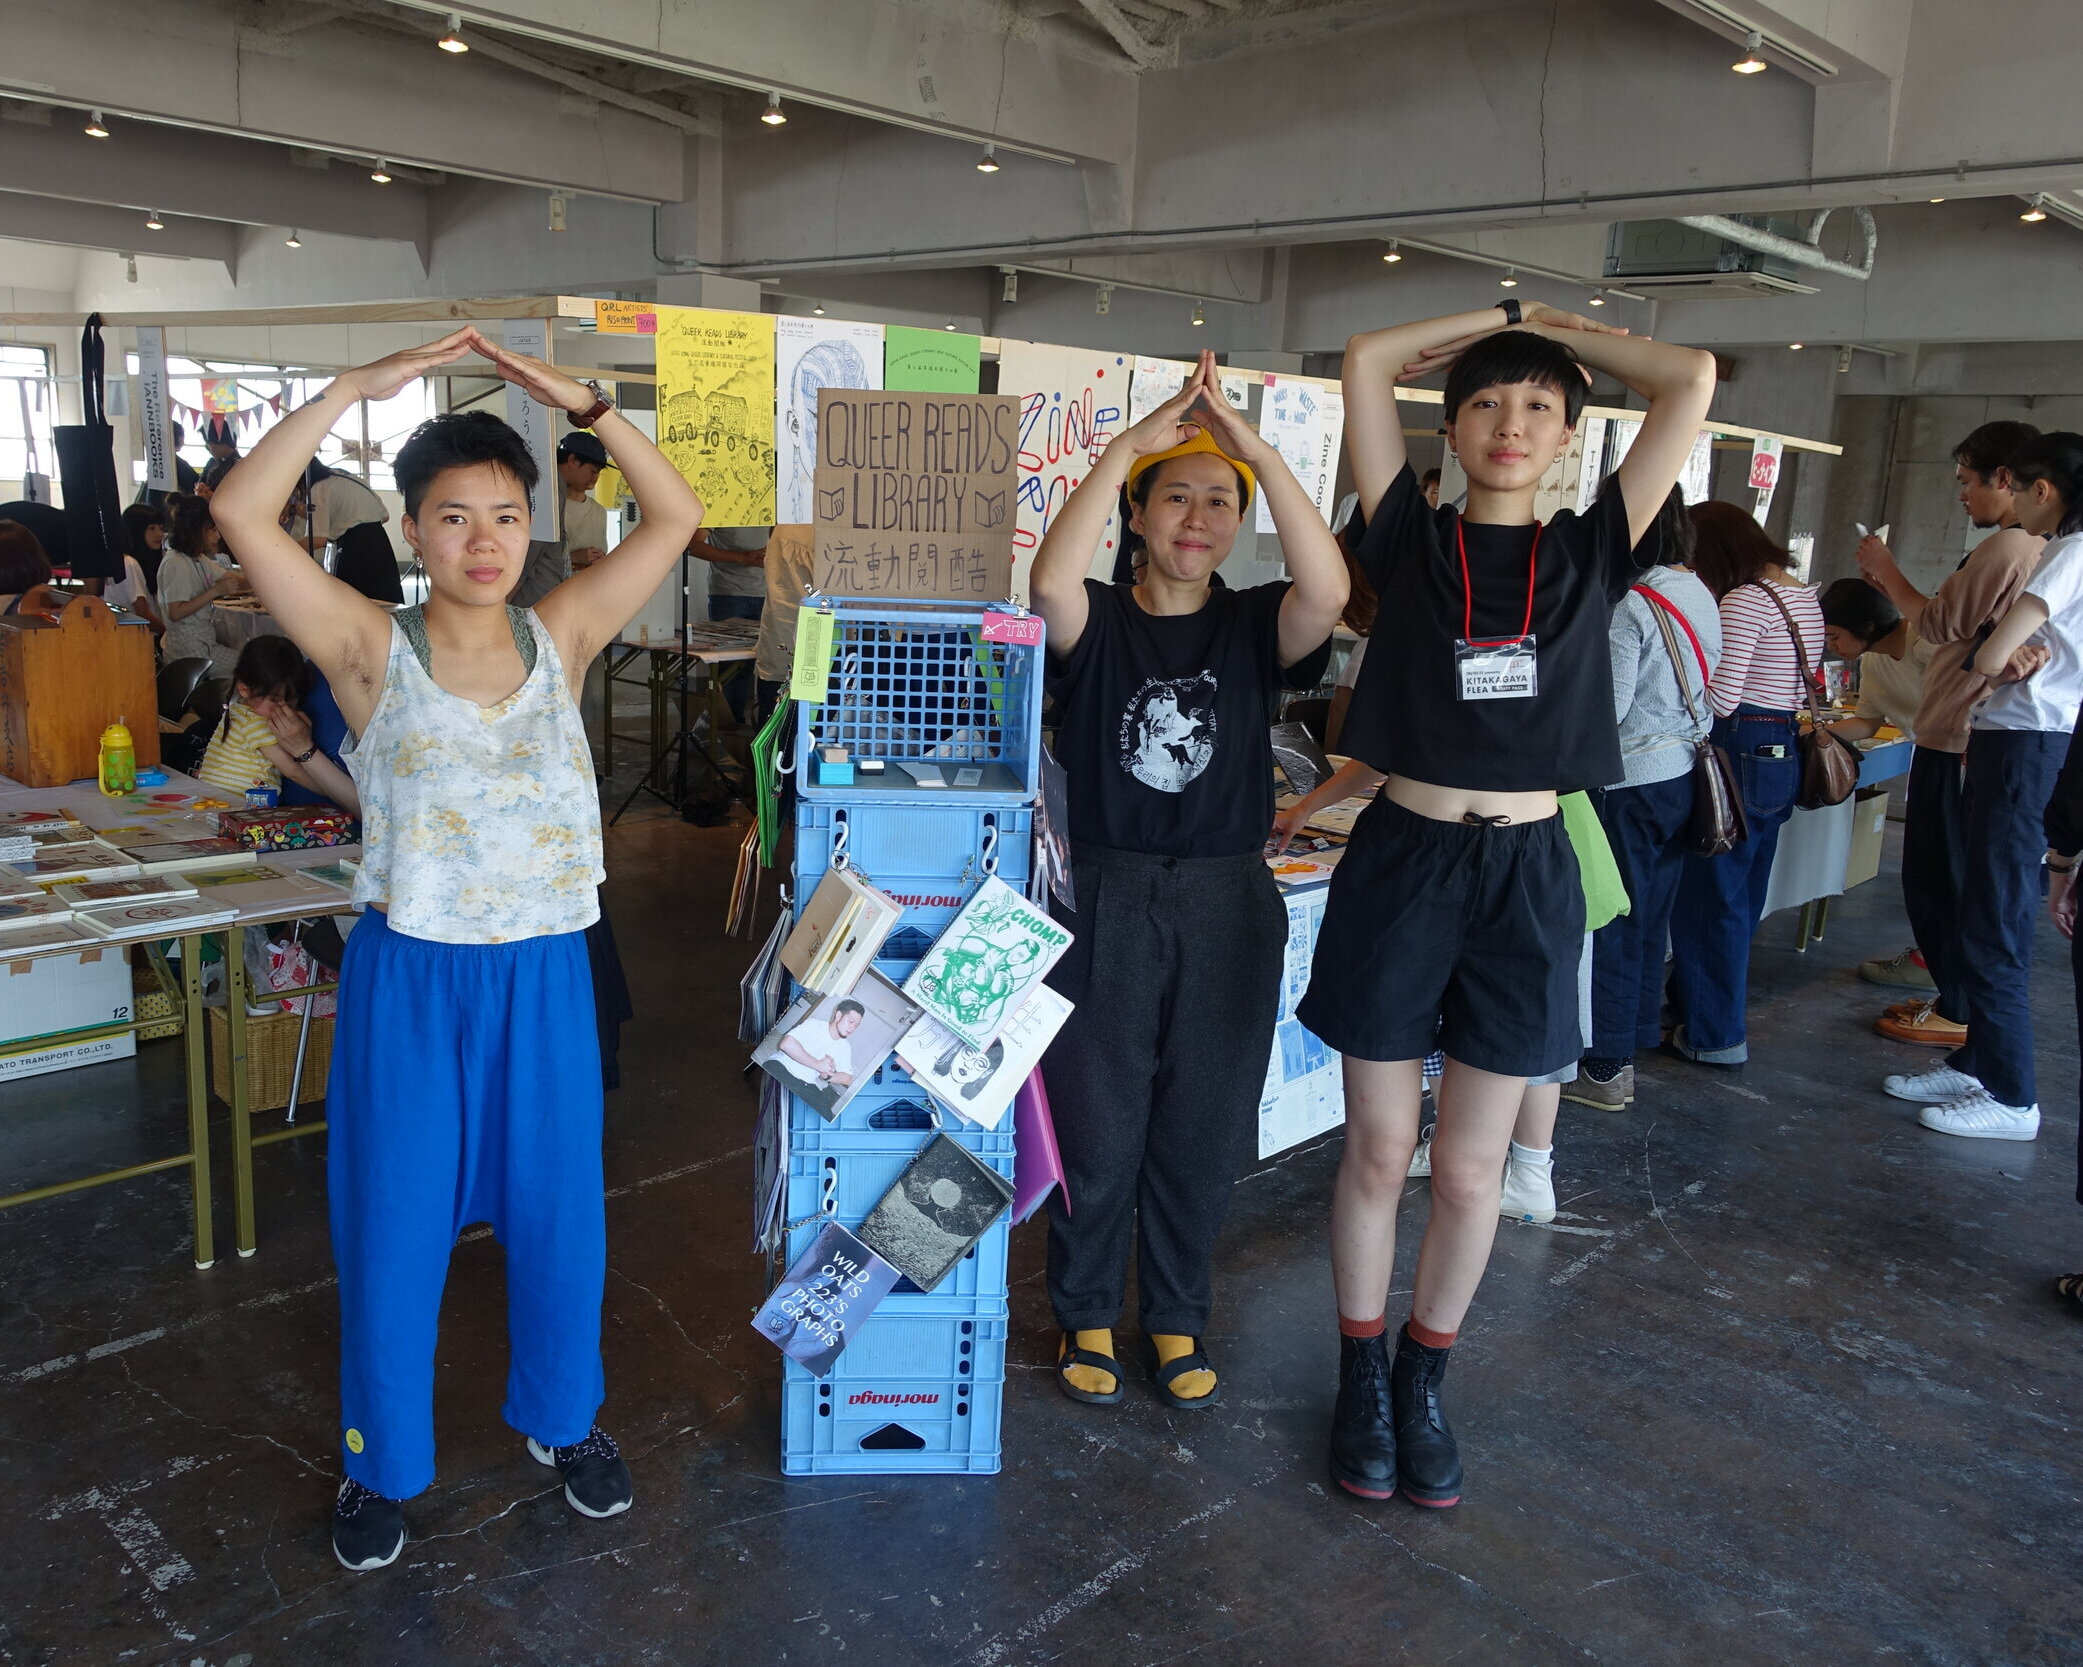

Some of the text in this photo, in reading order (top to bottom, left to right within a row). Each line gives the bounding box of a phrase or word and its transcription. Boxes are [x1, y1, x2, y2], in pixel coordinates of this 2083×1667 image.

[601, 303, 621, 312] QRL
[682, 327, 702, 337] QUEER
[826, 401, 1011, 475] QUEER READS
[1319, 433, 1332, 468] Zine
[852, 472, 967, 534] LIBRARY
[1004, 619, 1040, 639] TRY
[1467, 675, 1527, 685] KITAKAGAYA
[1467, 686, 1489, 694] FLEA
[1010, 908, 1068, 947] CHOMP
[112, 1006, 129, 1019] 12
[20, 1050, 74, 1066] TRANSPORT
[821, 1264, 863, 1298] OATS
[832, 1250, 870, 1283] WILD
[791, 1288, 845, 1332] PHOTO
[808, 1282, 849, 1314] 223'S
[781, 1300, 839, 1347] GRAPHS
[848, 1391, 939, 1407] morinaga
